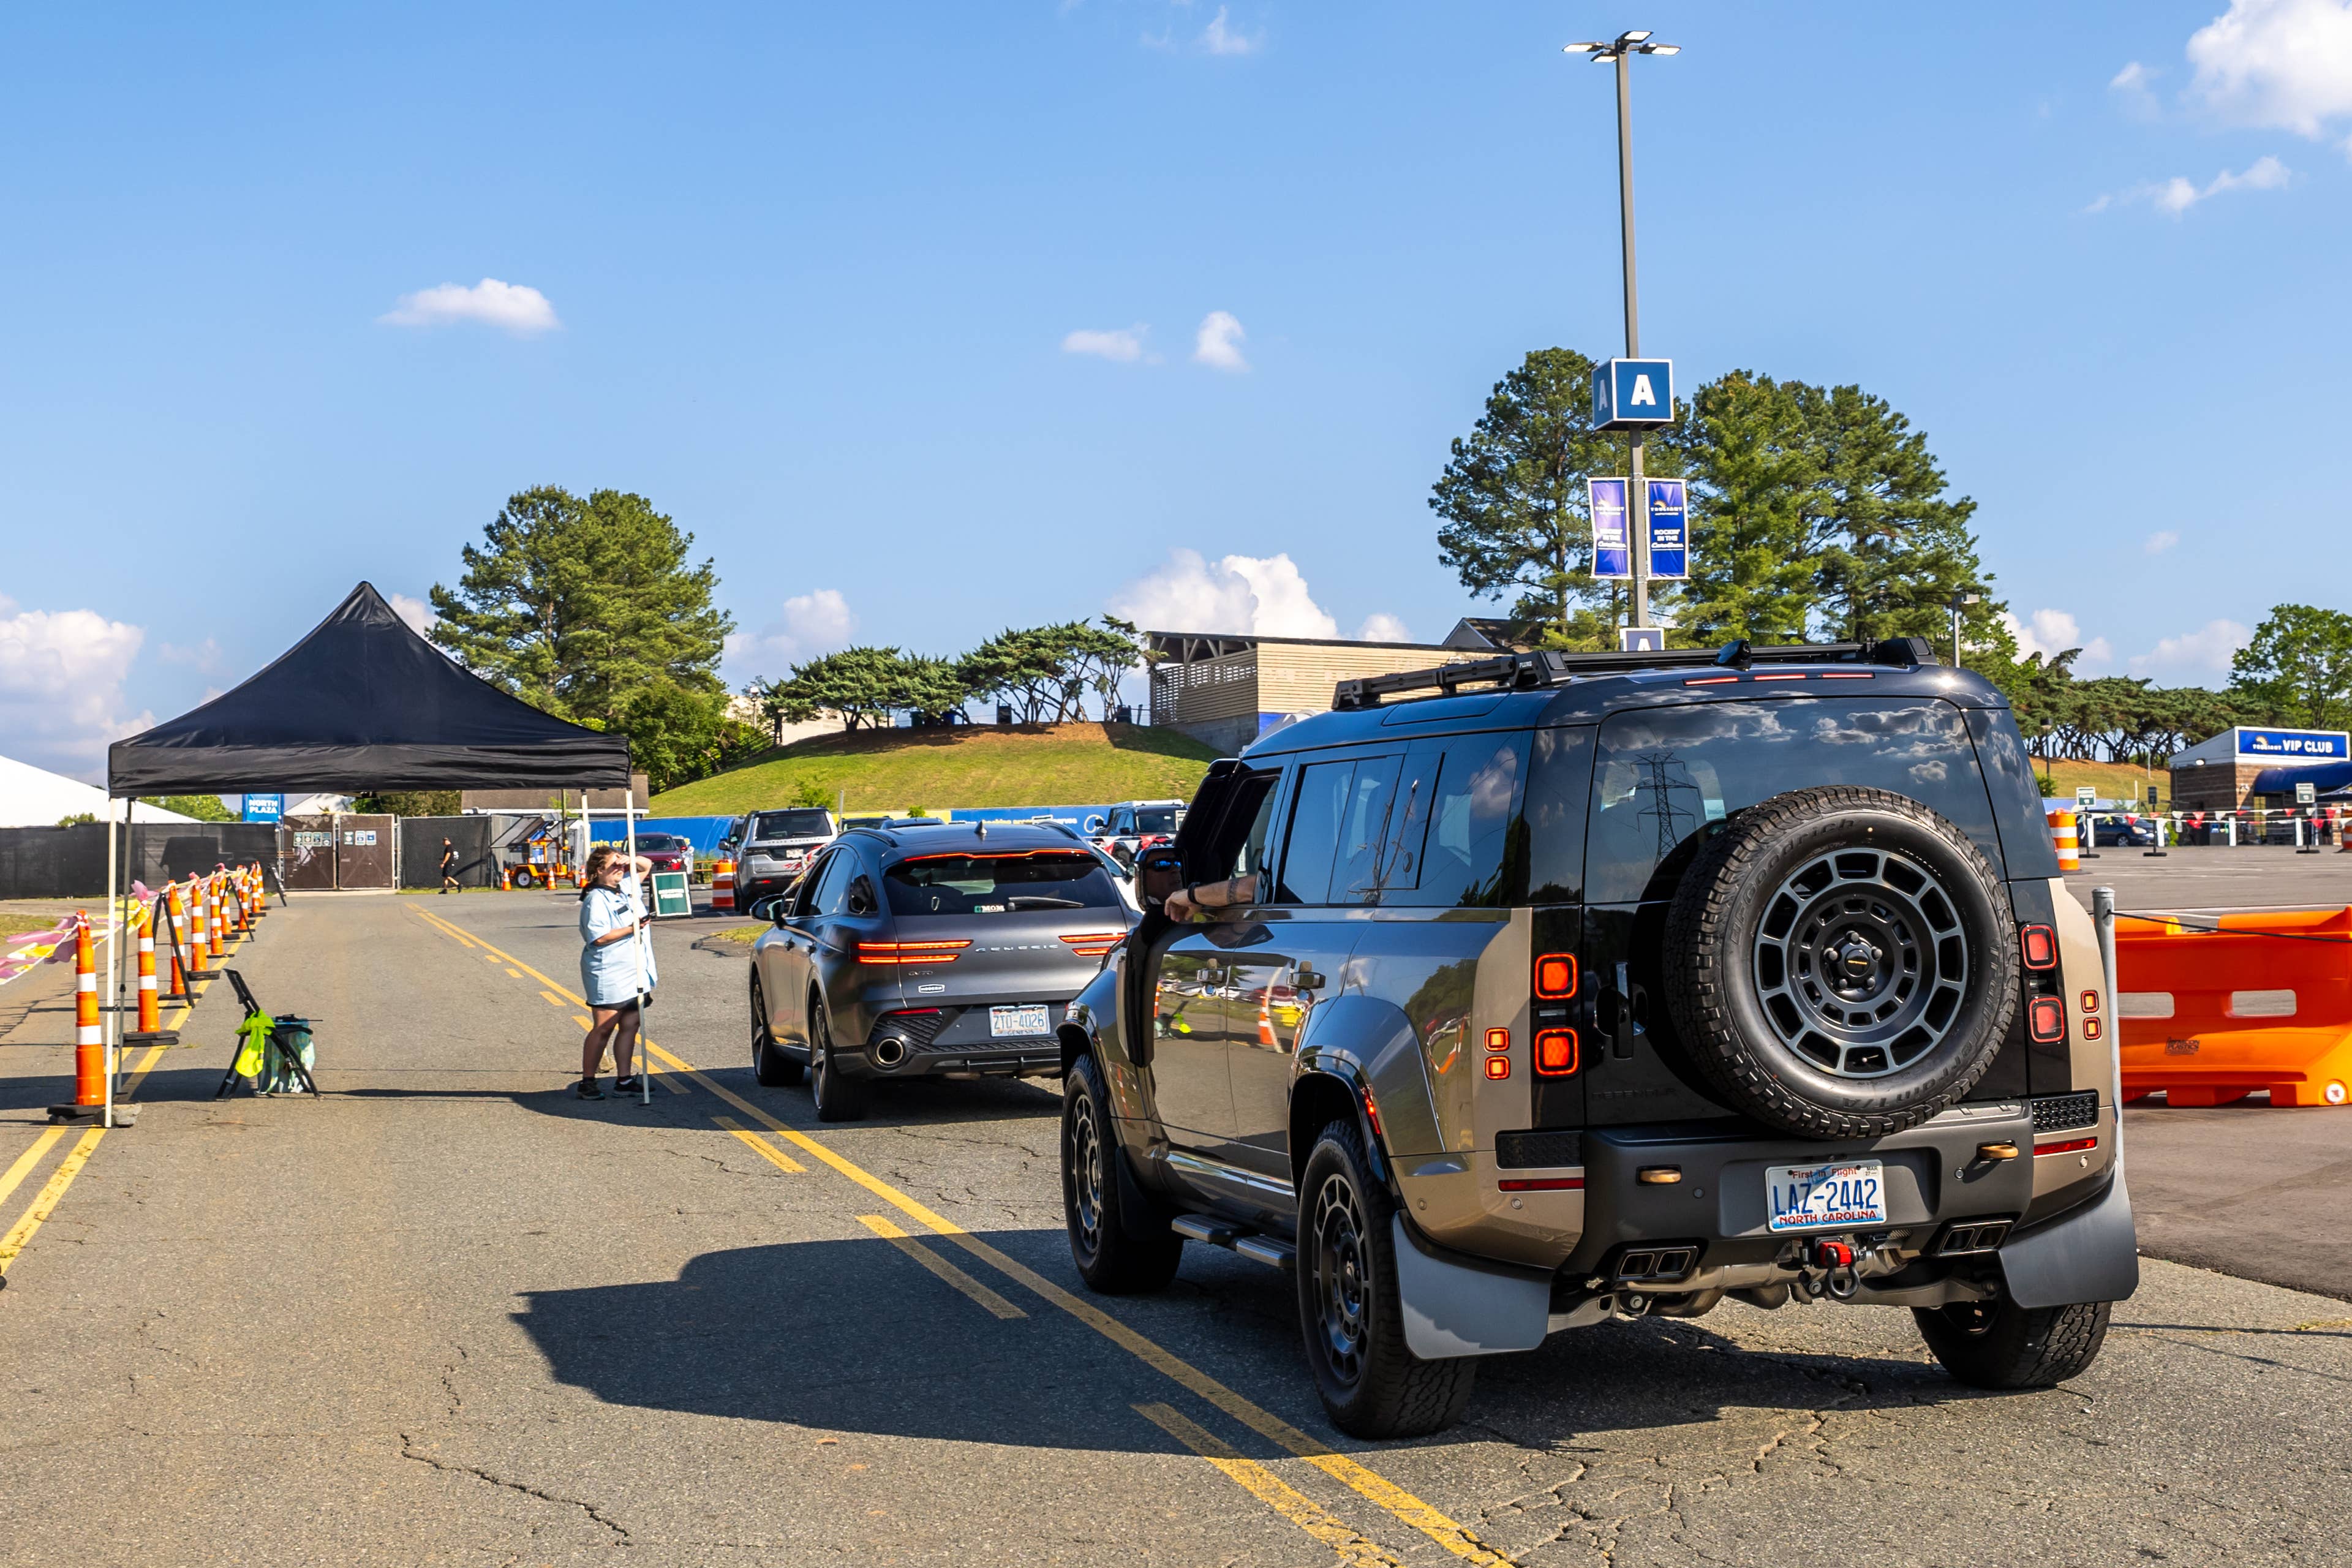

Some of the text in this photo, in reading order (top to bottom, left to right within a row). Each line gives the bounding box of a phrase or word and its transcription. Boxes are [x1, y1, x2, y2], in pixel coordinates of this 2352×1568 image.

[1599, 379, 1608, 411] A
[1630, 374, 1656, 405] A
[2282, 739, 2302, 752] VIP
[2304, 741, 2333, 753] CLUB
[975, 944, 1059, 952] GENESIS
[1792, 1169, 1813, 1179] First
[1831, 1167, 1857, 1178] Flight
[1773, 1178, 1879, 1215] LAZ-2442
[1779, 1210, 1877, 1224] NORTH CAROLINA
